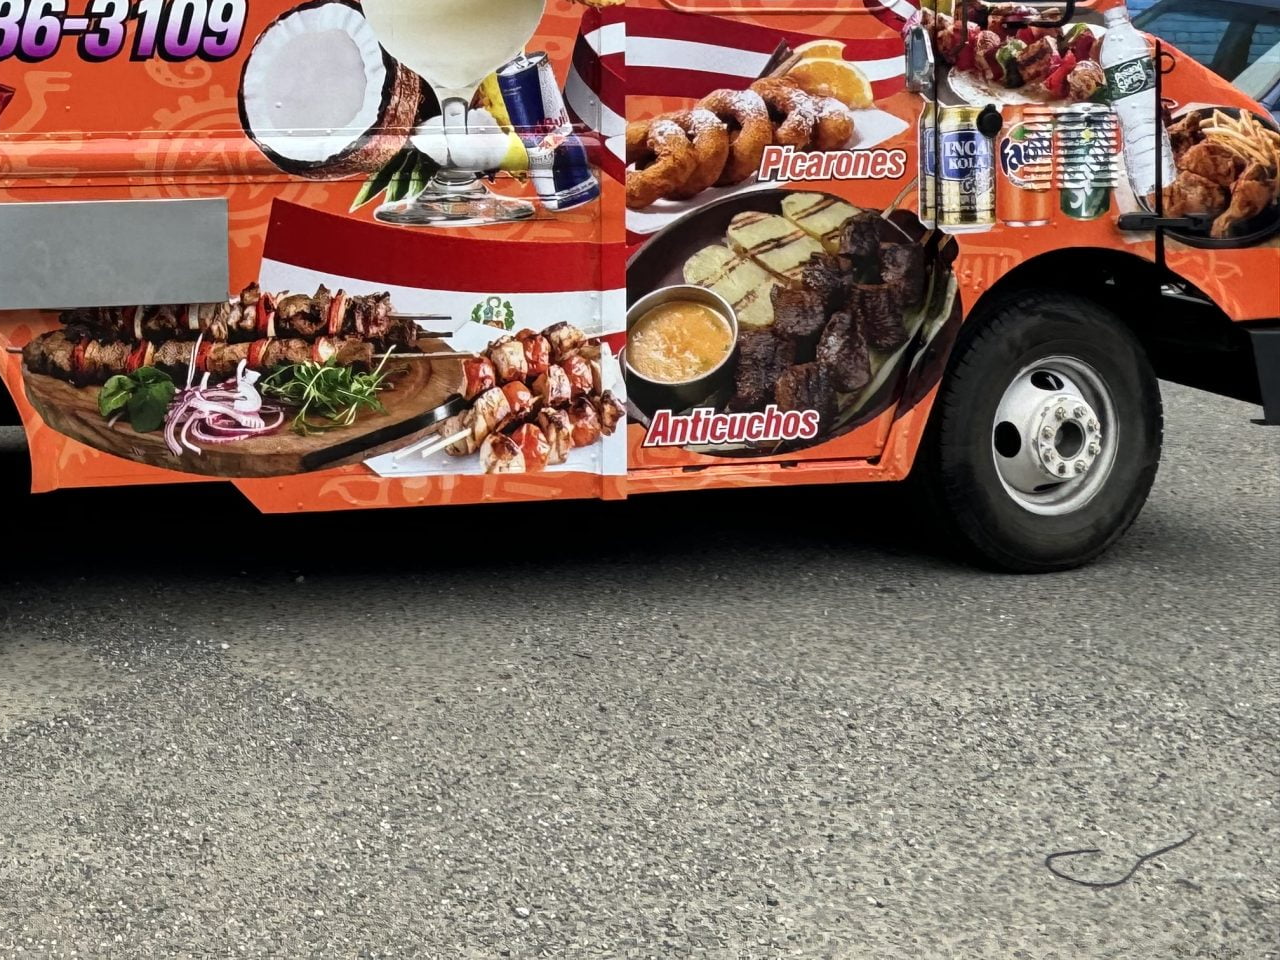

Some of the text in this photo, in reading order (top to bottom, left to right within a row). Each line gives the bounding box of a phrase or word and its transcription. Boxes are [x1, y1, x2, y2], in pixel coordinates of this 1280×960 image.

[943, 139, 988, 157] INCA
[758, 144, 907, 181] Picarones
[948, 157, 987, 170] KOLA
[641, 404, 819, 448] Anticuchos
